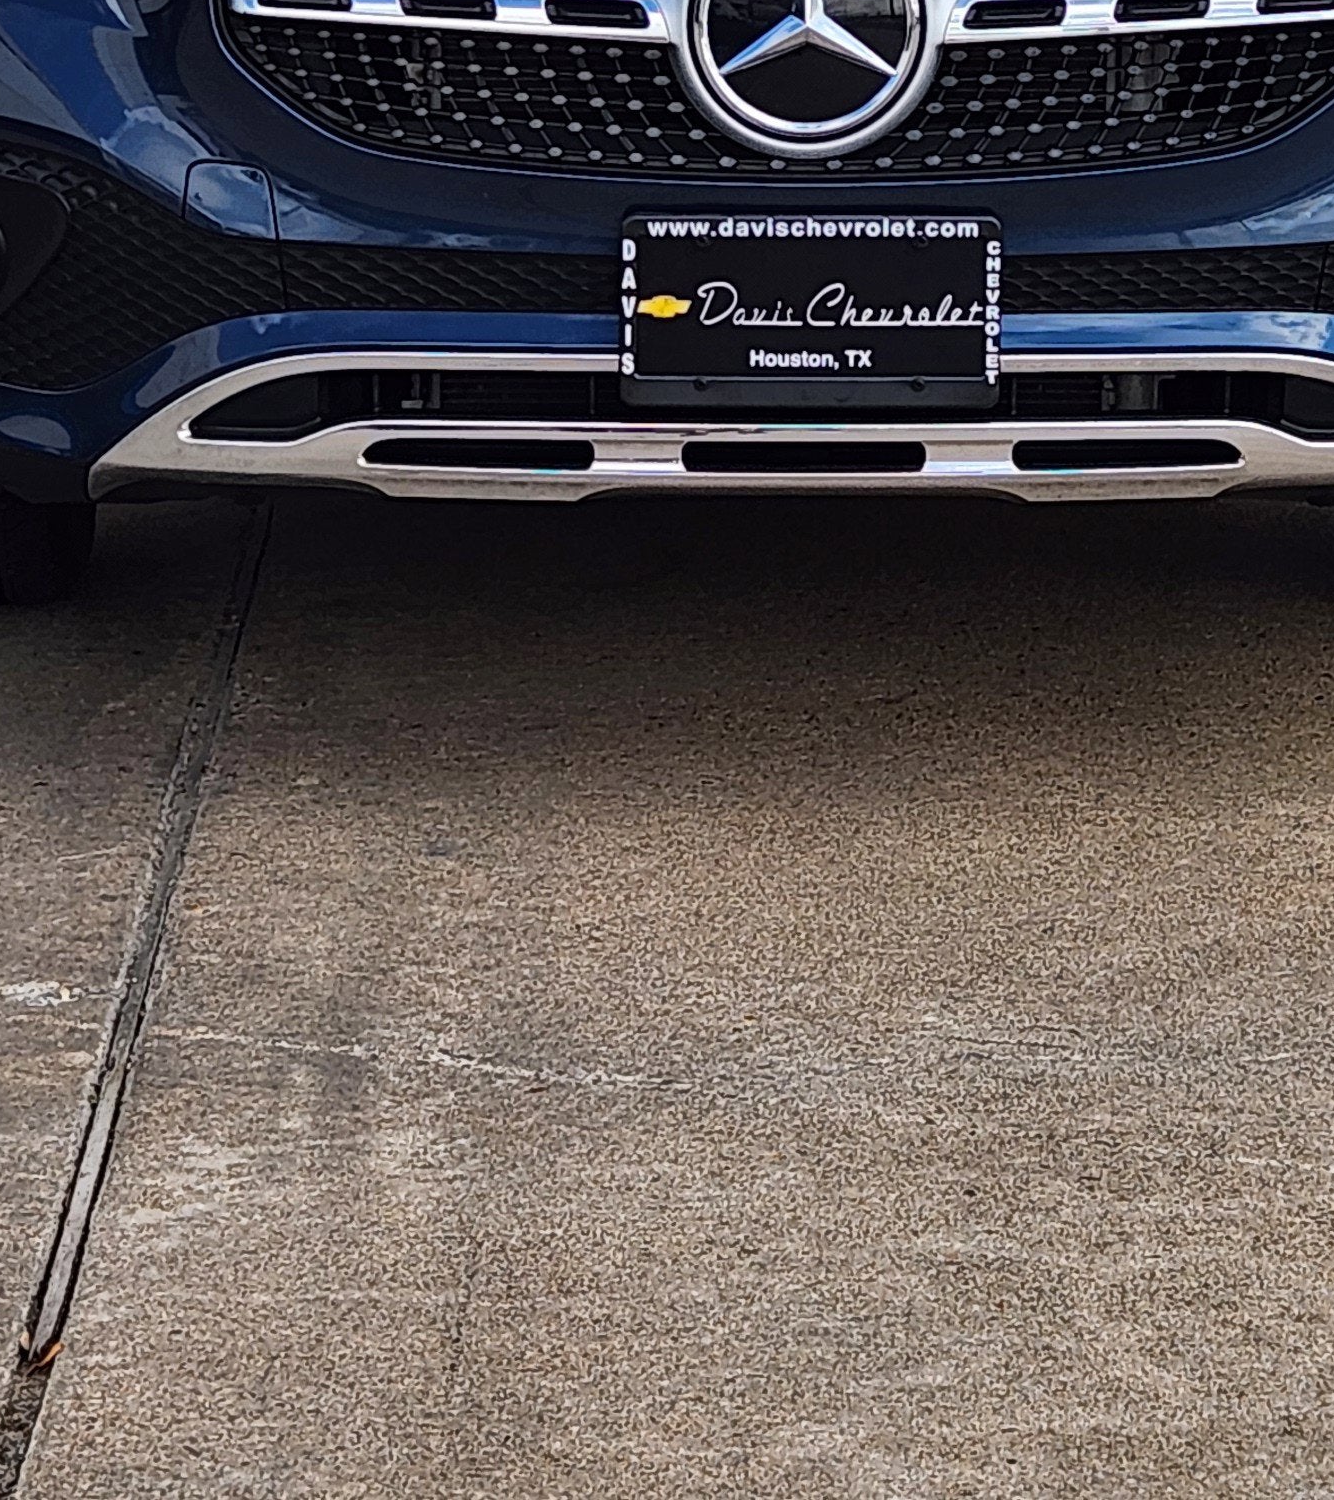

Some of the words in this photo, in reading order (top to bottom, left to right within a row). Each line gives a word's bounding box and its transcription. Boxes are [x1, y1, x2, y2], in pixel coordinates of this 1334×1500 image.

[647, 216, 979, 238] www.davischevrolet.com
[620, 238, 637, 375] DAVIS
[696, 281, 804, 326] Davis
[806, 282, 985, 327] Chevrolet
[984, 240, 1002, 385] CHEVROLET
[749, 348, 839, 370] Houston,
[844, 348, 873, 369] TX
